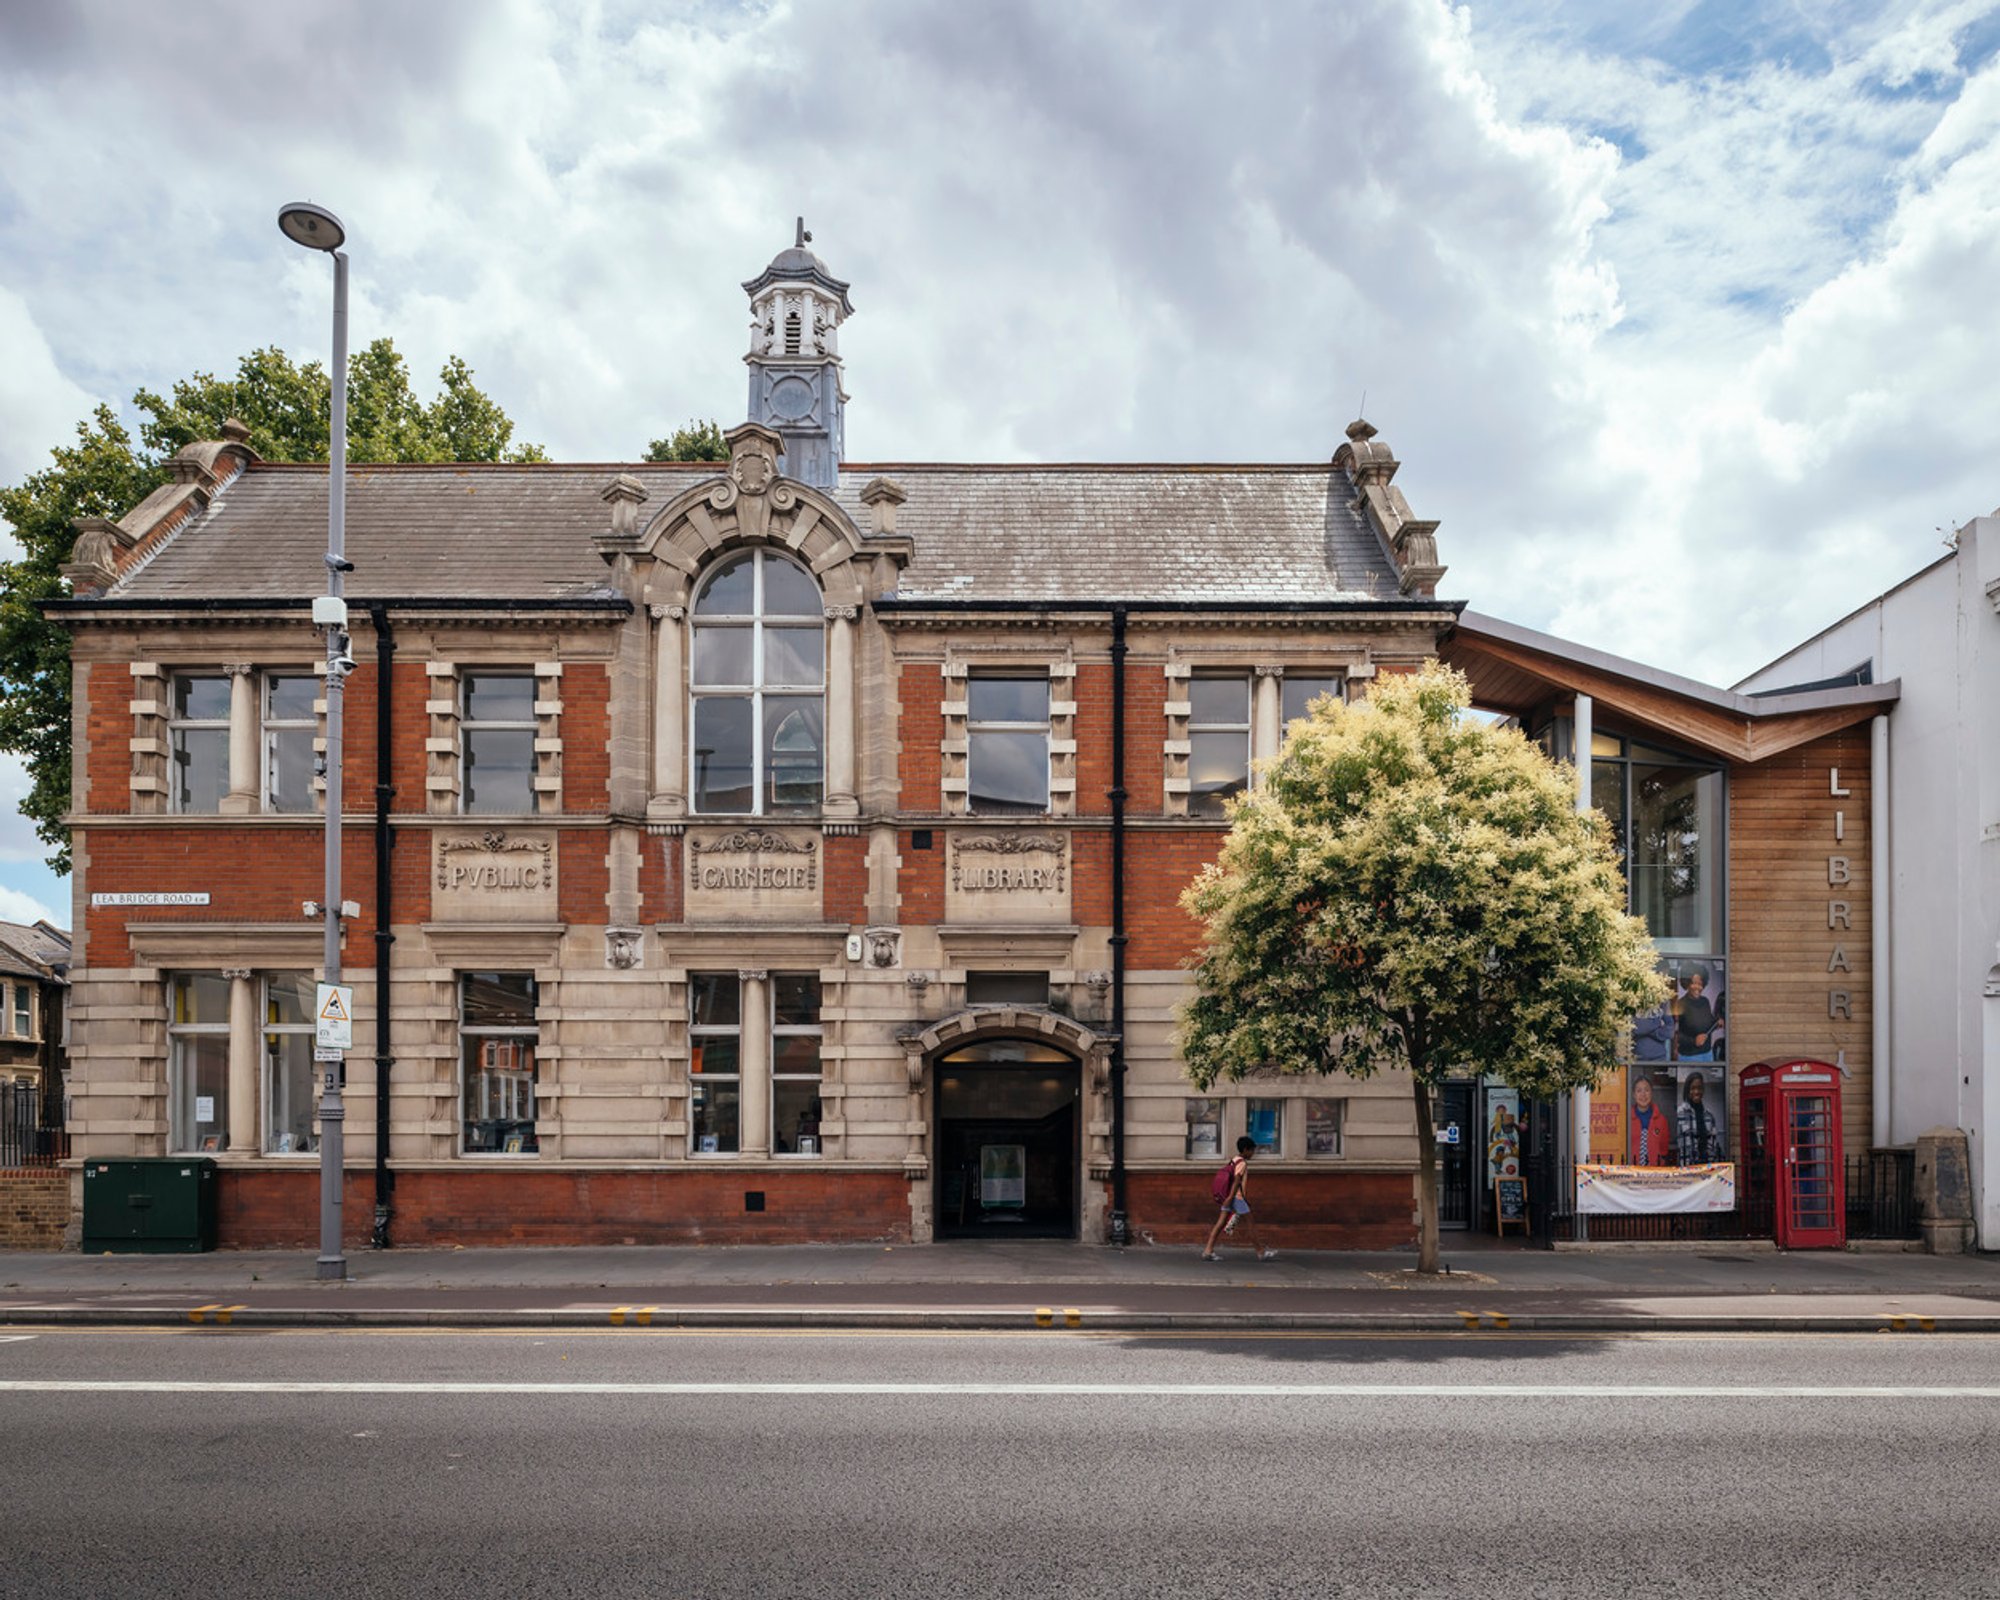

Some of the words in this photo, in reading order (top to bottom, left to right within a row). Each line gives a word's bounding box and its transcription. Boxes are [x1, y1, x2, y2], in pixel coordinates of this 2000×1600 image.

[702, 866, 806, 889] CARNEGIE
[962, 868, 1056, 889] LIBRARY
[96, 894, 115, 903] LEA
[119, 894, 158, 904] BRIDGE
[163, 894, 192, 904] ROAD
[1828, 767, 1852, 1078] LIBRARY
[1590, 1113, 1619, 1125] PPORT
